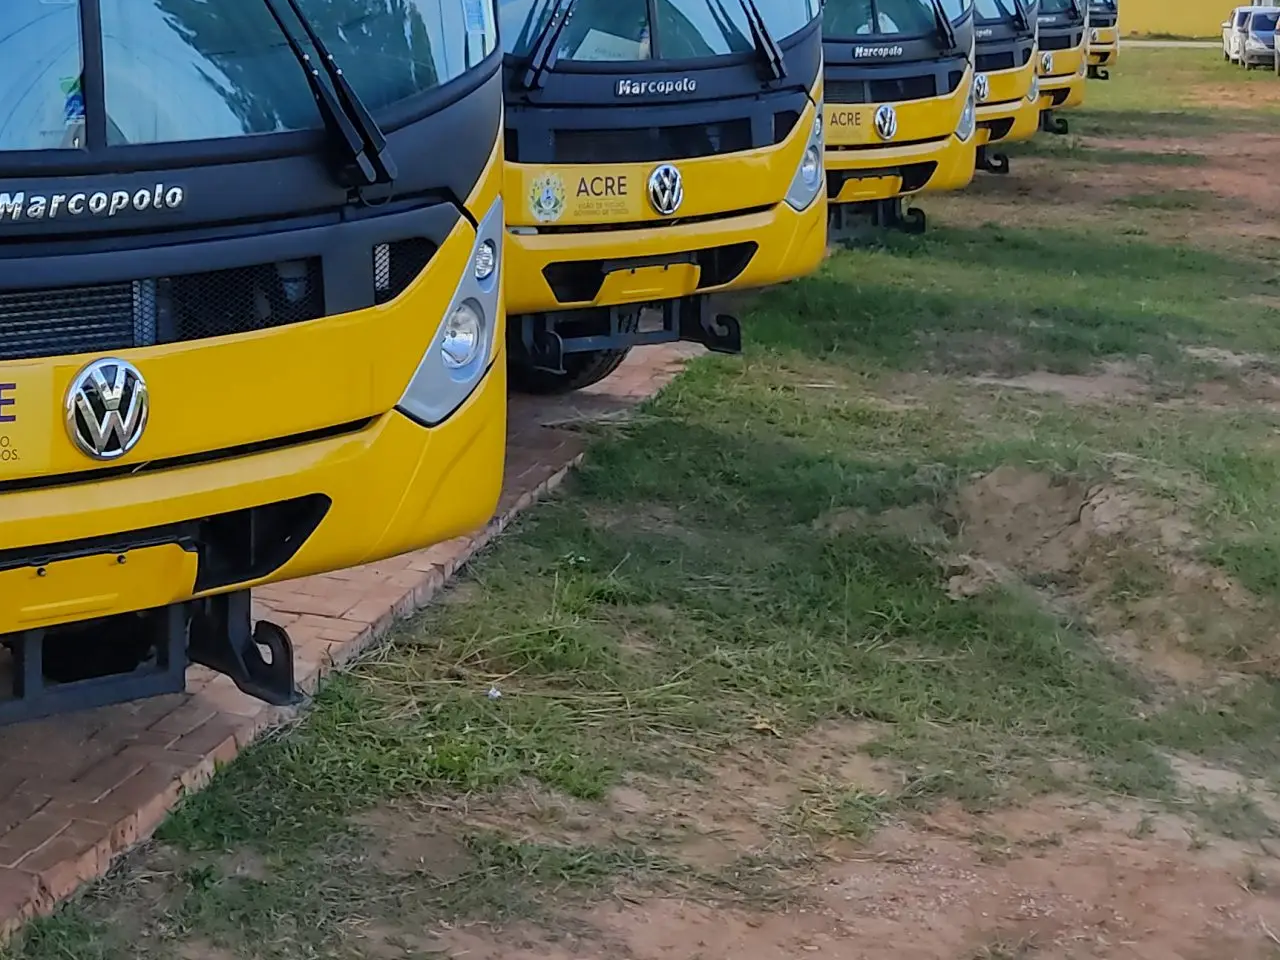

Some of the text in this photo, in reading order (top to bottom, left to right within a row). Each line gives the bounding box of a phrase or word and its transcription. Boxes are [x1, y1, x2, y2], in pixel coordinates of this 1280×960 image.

[855, 46, 902, 58] Marcopolo
[618, 78, 696, 95] Marcopolo
[830, 112, 861, 126] ACRE
[576, 176, 627, 197] ACRE
